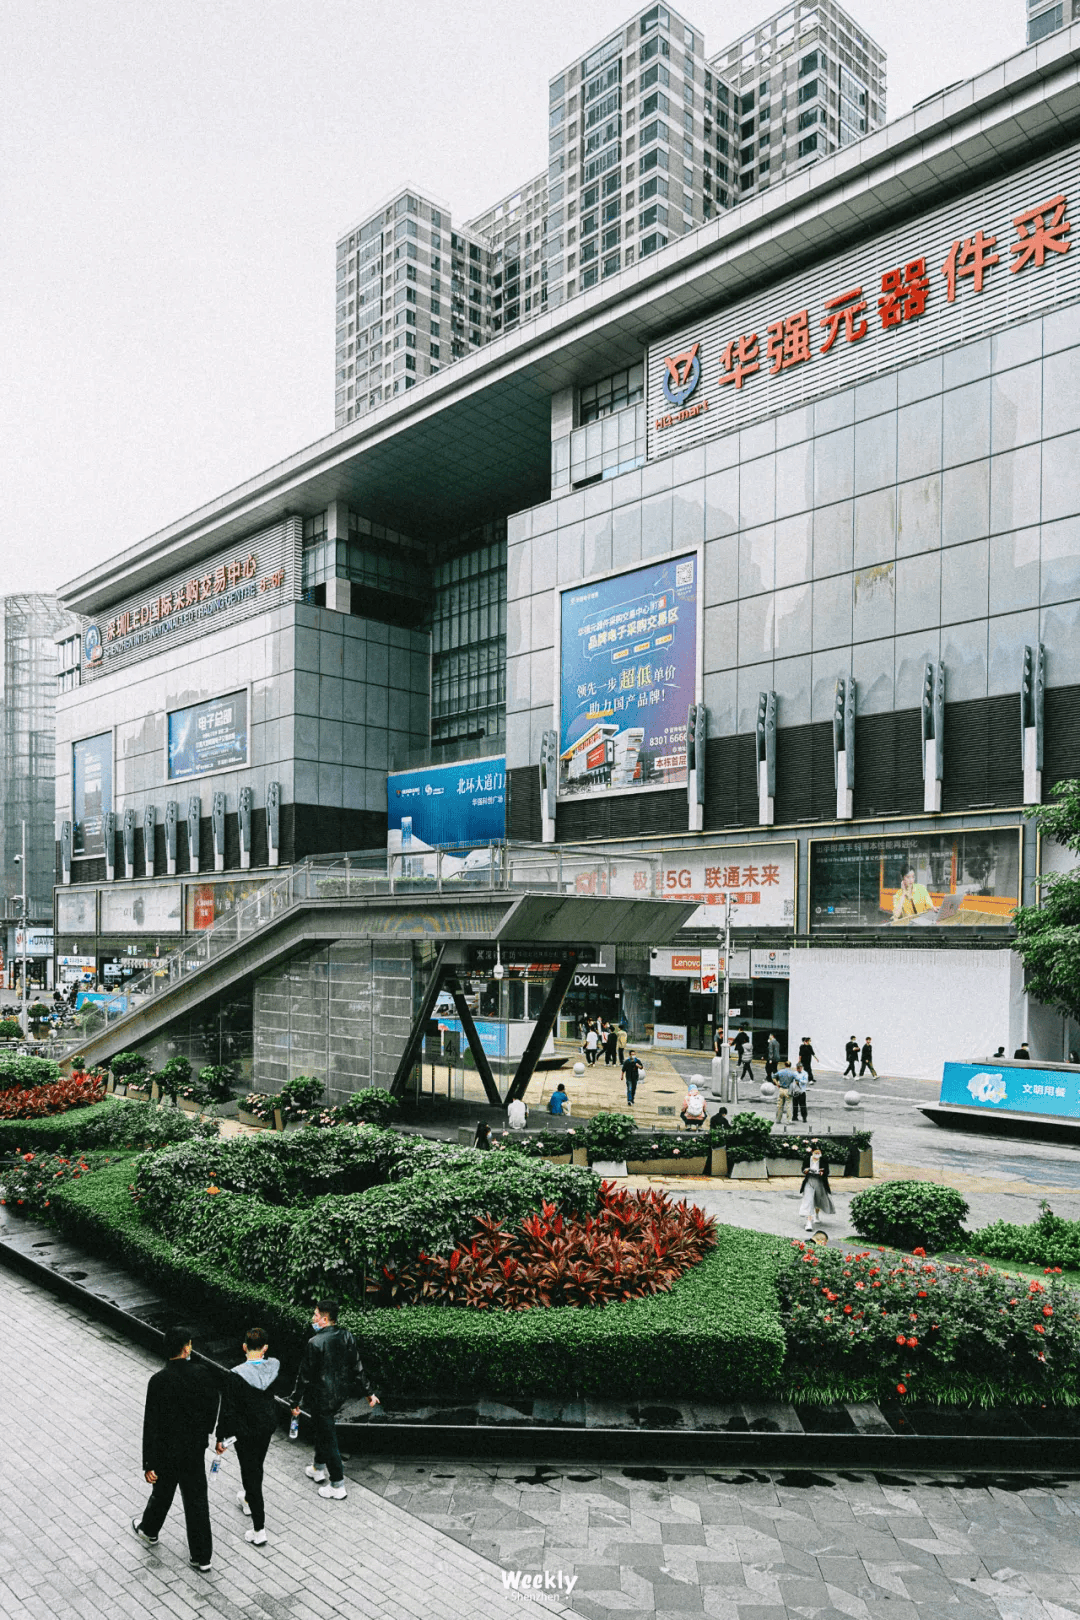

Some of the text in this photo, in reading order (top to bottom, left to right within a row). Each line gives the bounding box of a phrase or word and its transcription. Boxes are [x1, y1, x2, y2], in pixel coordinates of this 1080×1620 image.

[717, 193, 1073, 390] 华强元器件采
[655, 398, 709, 431] HQ-mart
[456, 772, 506, 795] 北环大道门
[704, 863, 780, 889] 联通未来
[574, 974, 599, 987] DELL
[1022, 1083, 1067, 1098] 文明用餐
